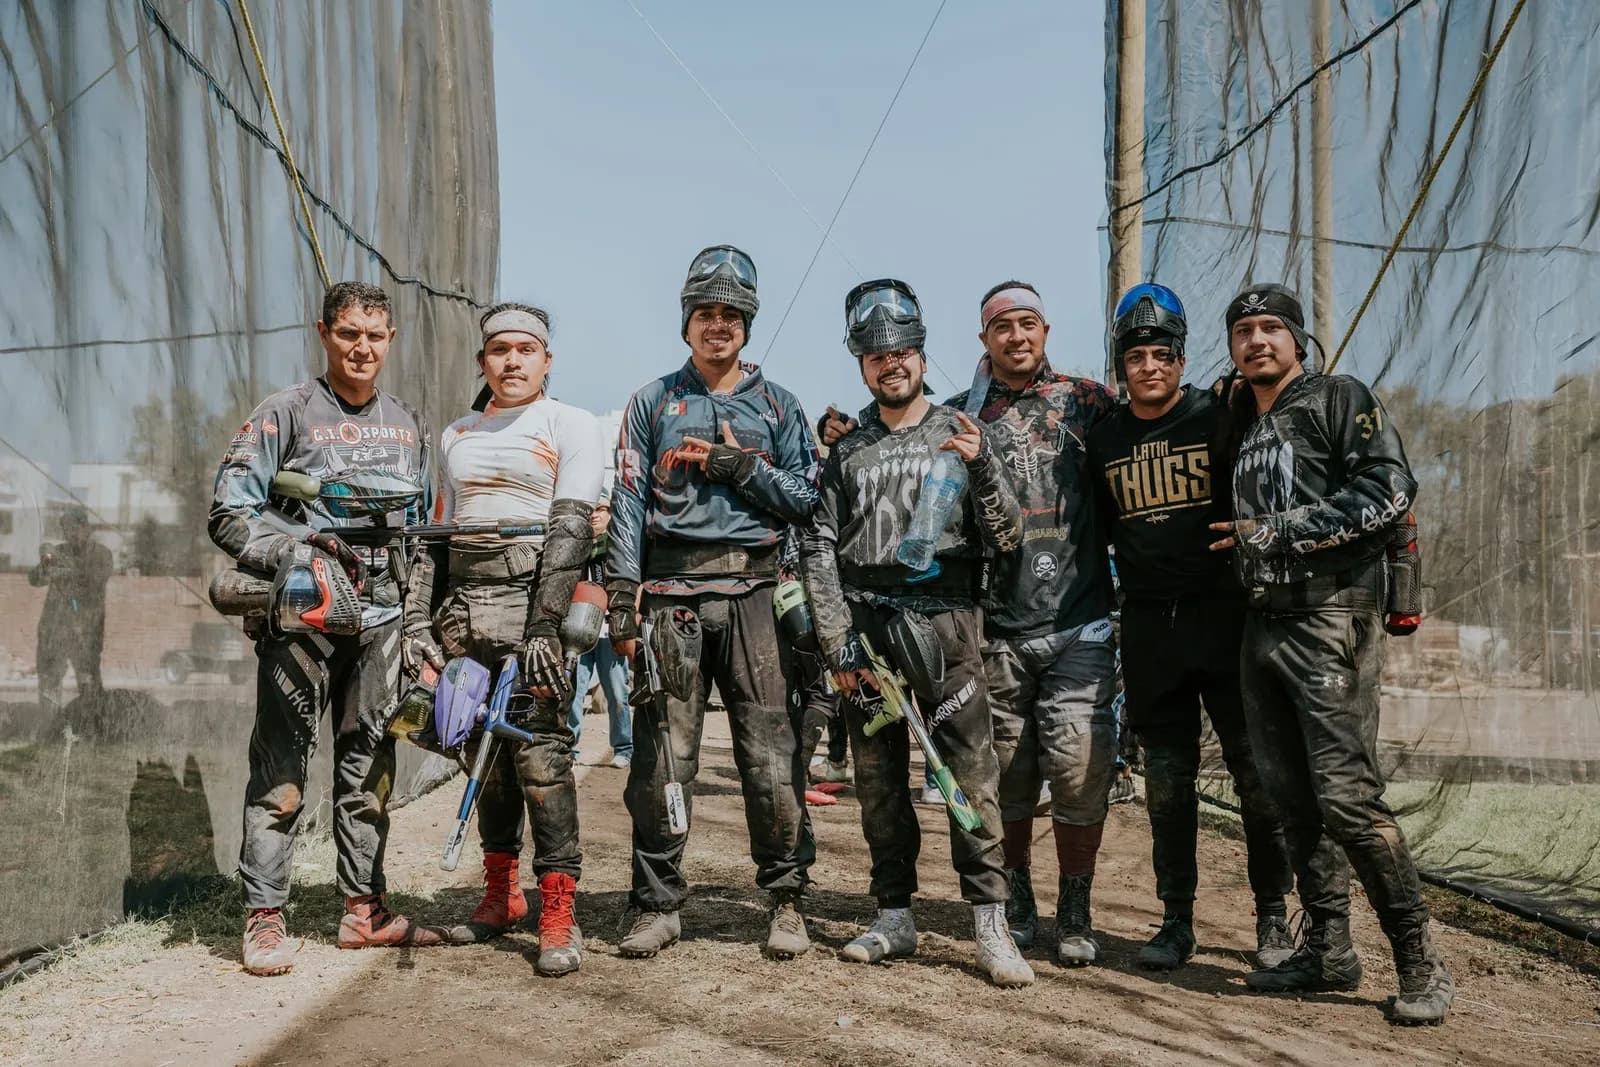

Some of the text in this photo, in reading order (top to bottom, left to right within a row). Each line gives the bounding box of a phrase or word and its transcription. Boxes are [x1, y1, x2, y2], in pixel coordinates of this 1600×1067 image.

[361, 426, 413, 443] SPORTZ
[1355, 407, 1383, 440] 31
[1133, 440, 1169, 462] LATIN
[1105, 451, 1211, 512] THUGS
[980, 492, 1009, 530] Dark
[1292, 491, 1409, 554] Dark Side
[839, 640, 858, 666] DS
